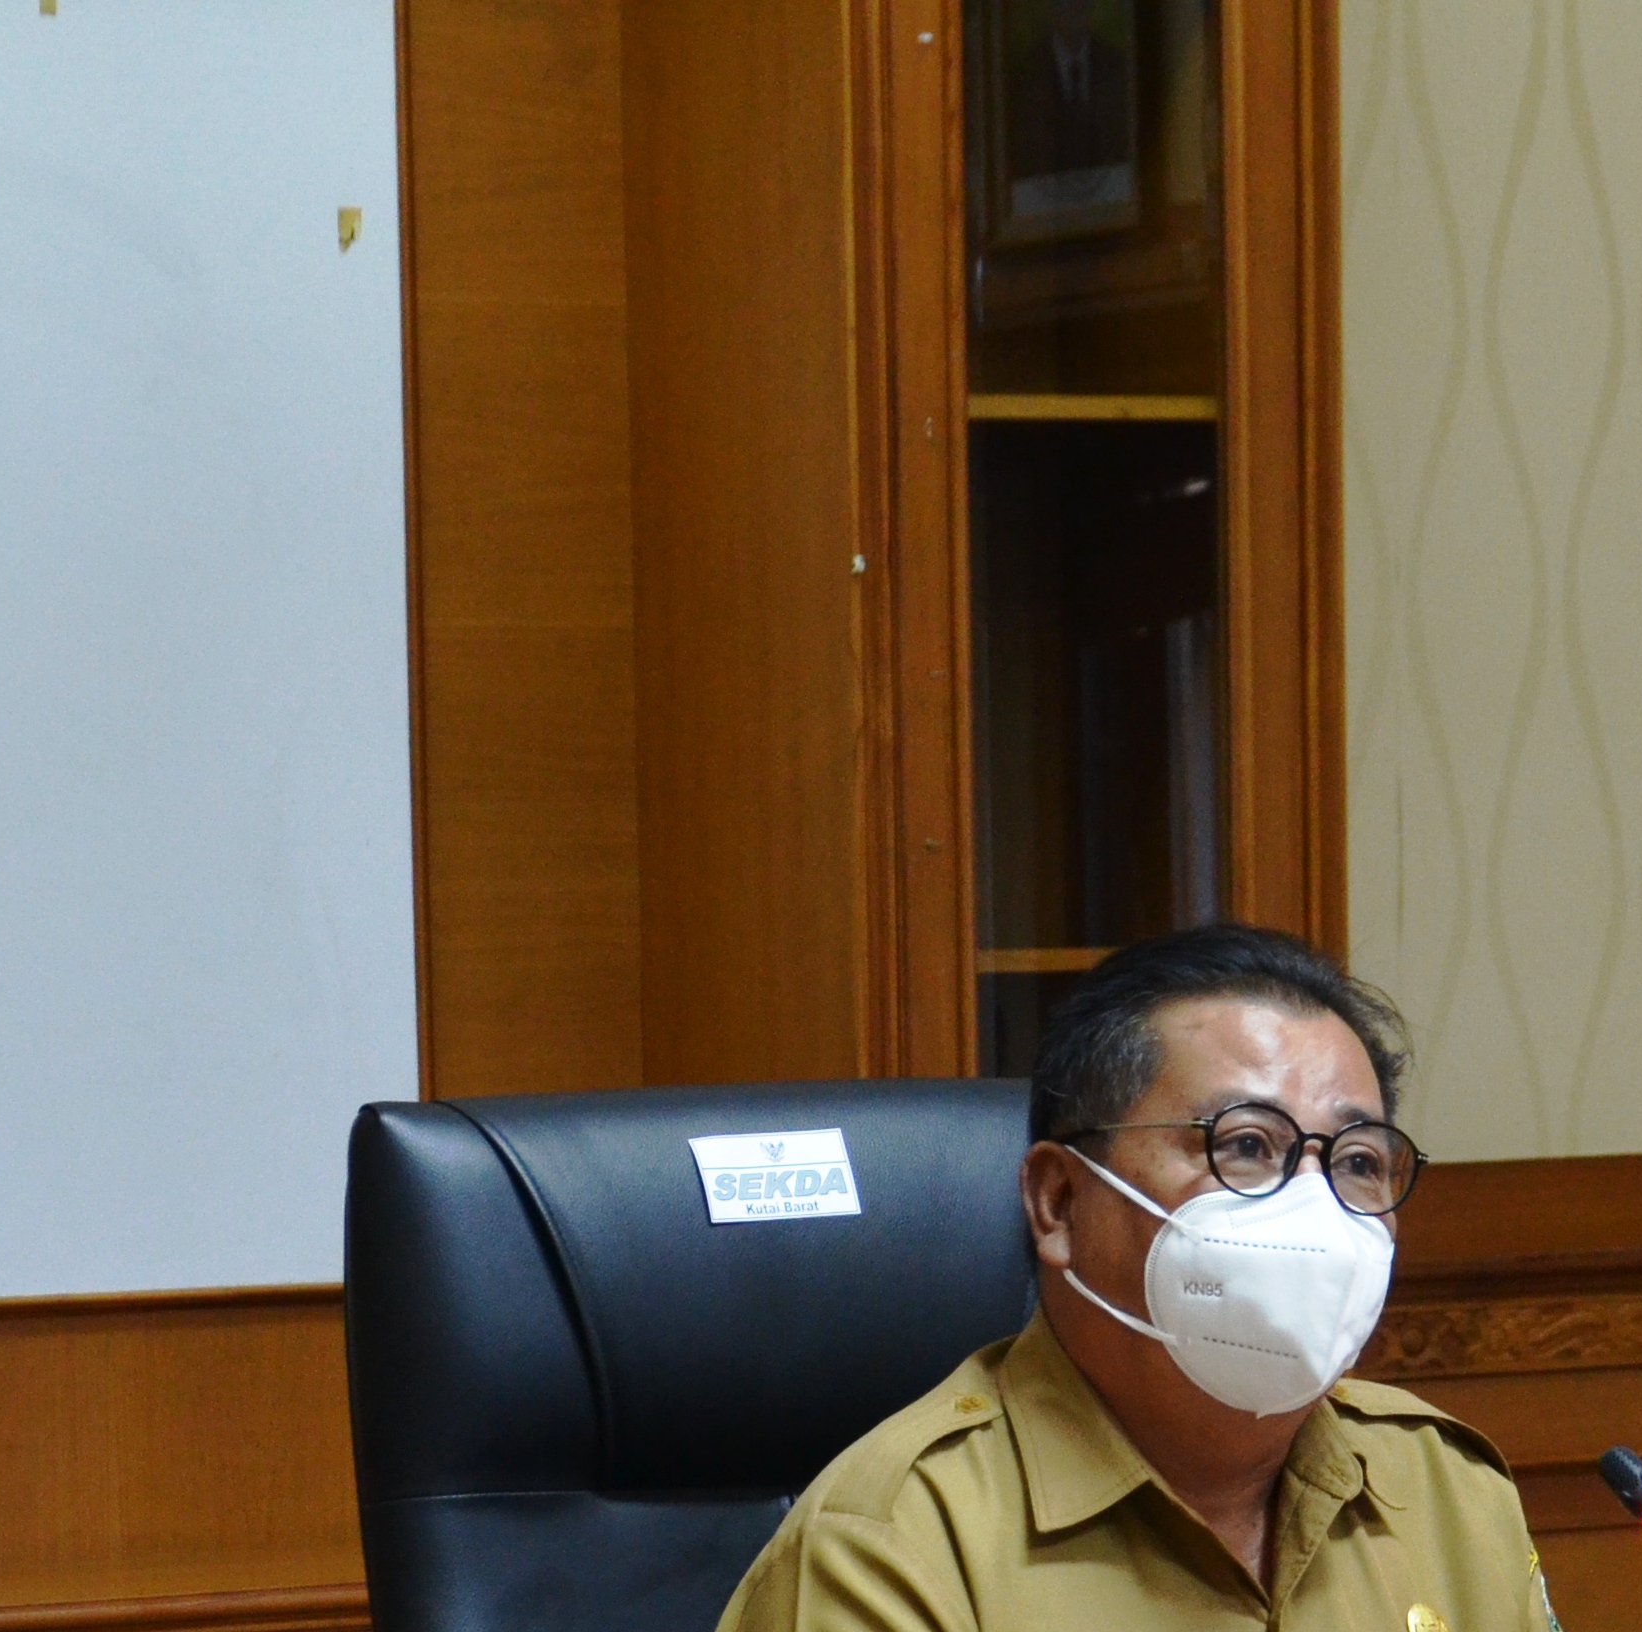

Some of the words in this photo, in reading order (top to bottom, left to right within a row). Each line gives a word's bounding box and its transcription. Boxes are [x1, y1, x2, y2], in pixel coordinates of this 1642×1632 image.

[713, 1167, 848, 1202] SEKDA
[746, 1203, 780, 1215] Kutai
[784, 1201, 819, 1213] Barat
[1183, 1280, 1223, 1298] KN95
